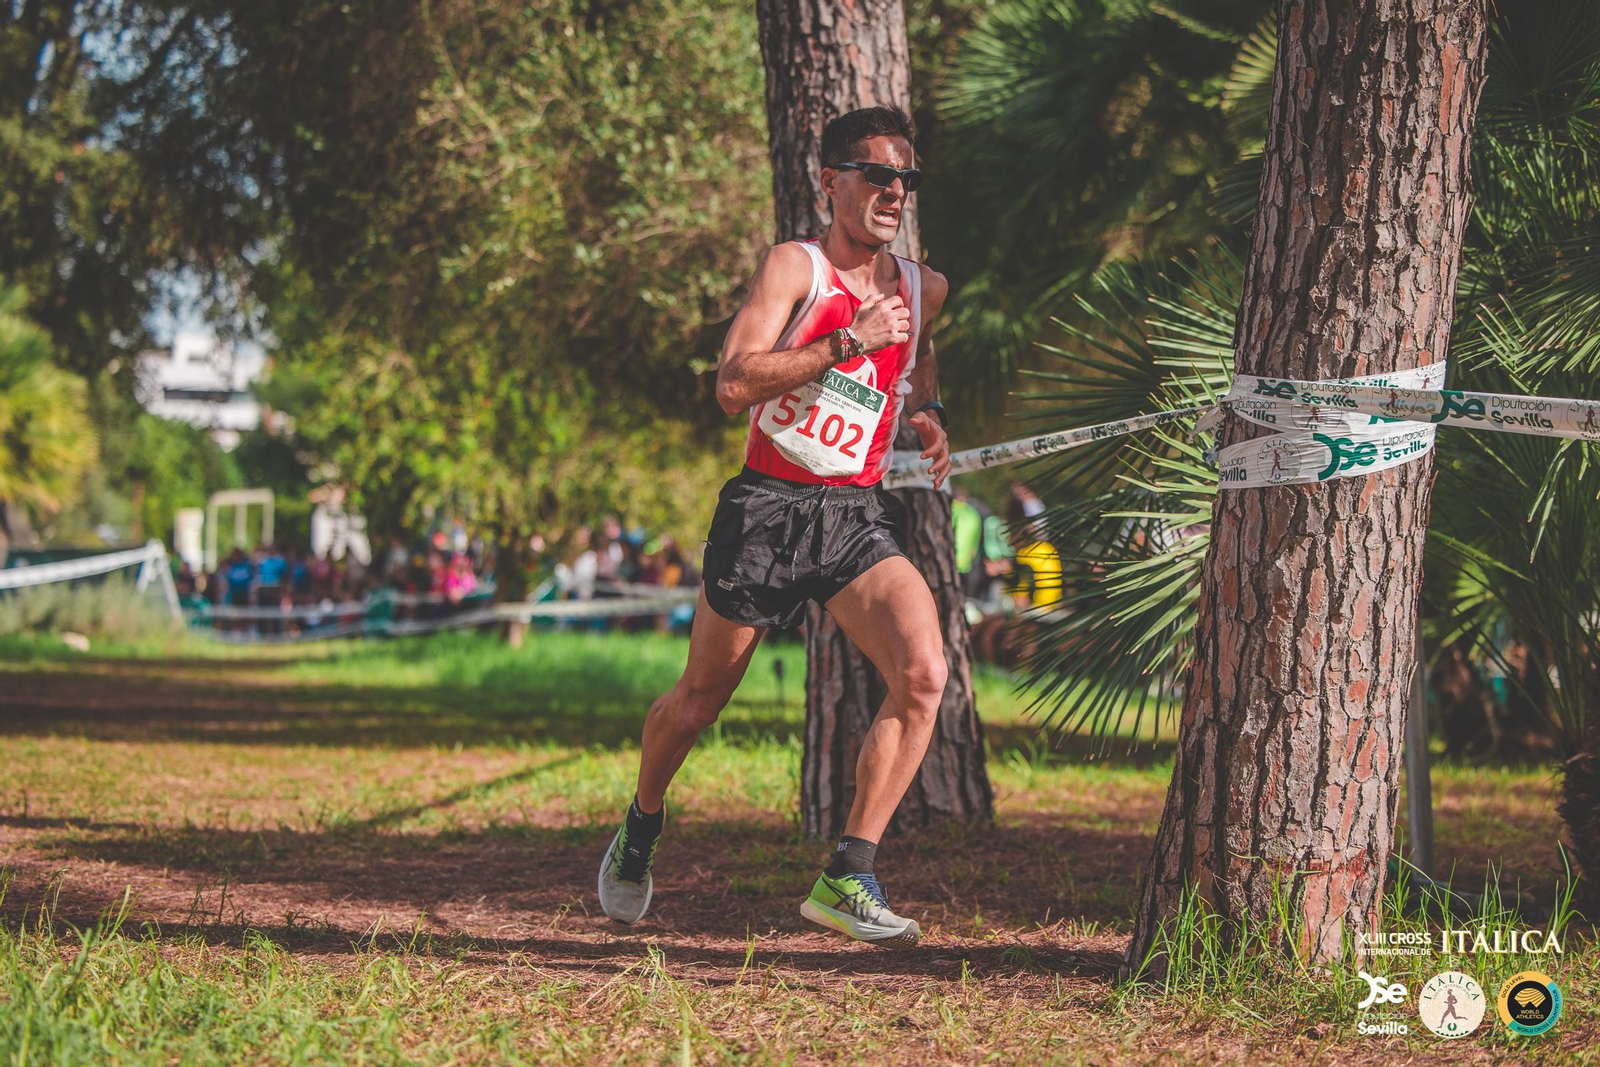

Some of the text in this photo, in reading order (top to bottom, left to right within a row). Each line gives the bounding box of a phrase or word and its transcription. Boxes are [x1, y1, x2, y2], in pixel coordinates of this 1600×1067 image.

[821, 372, 860, 399] TÁLICA
[1300, 392, 1359, 409] Sevilla
[1491, 396, 1553, 412] Diputación
[771, 393, 864, 459] 5102
[1491, 410, 1554, 429] Sevilla
